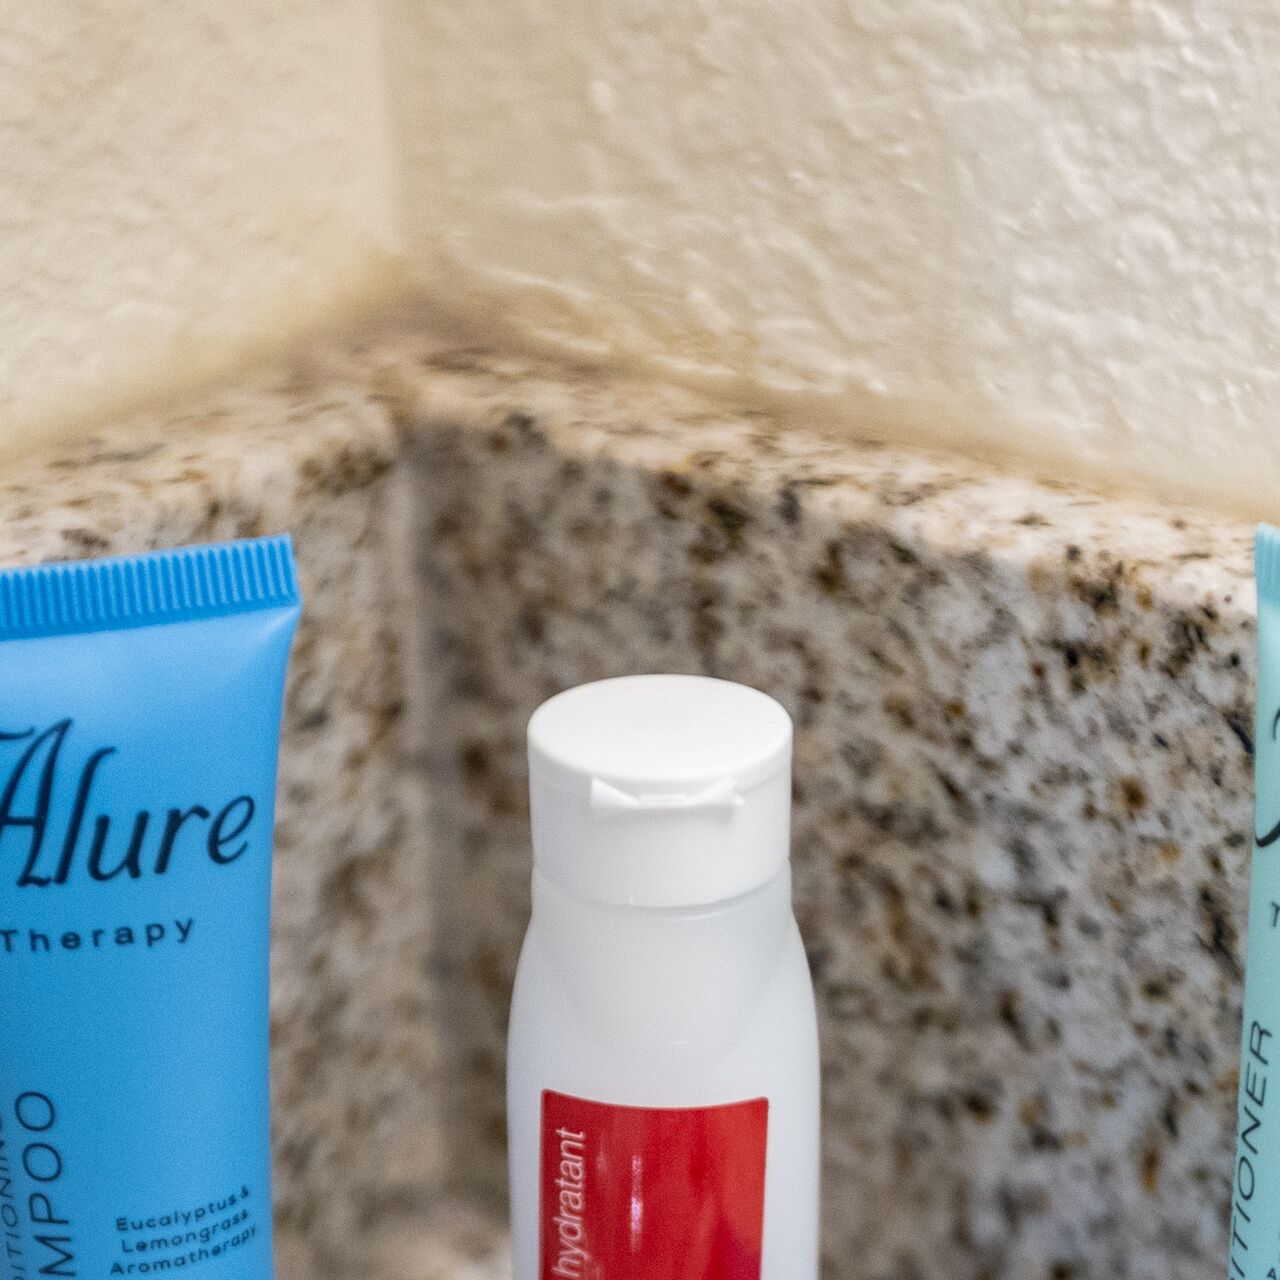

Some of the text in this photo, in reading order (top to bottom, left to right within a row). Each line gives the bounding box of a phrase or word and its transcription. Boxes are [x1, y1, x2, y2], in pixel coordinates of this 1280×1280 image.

[115, 1194, 237, 1232] Eucalyptus
[553, 1127, 589, 1278] hydratant
[121, 1208, 248, 1253] Lemongrass
